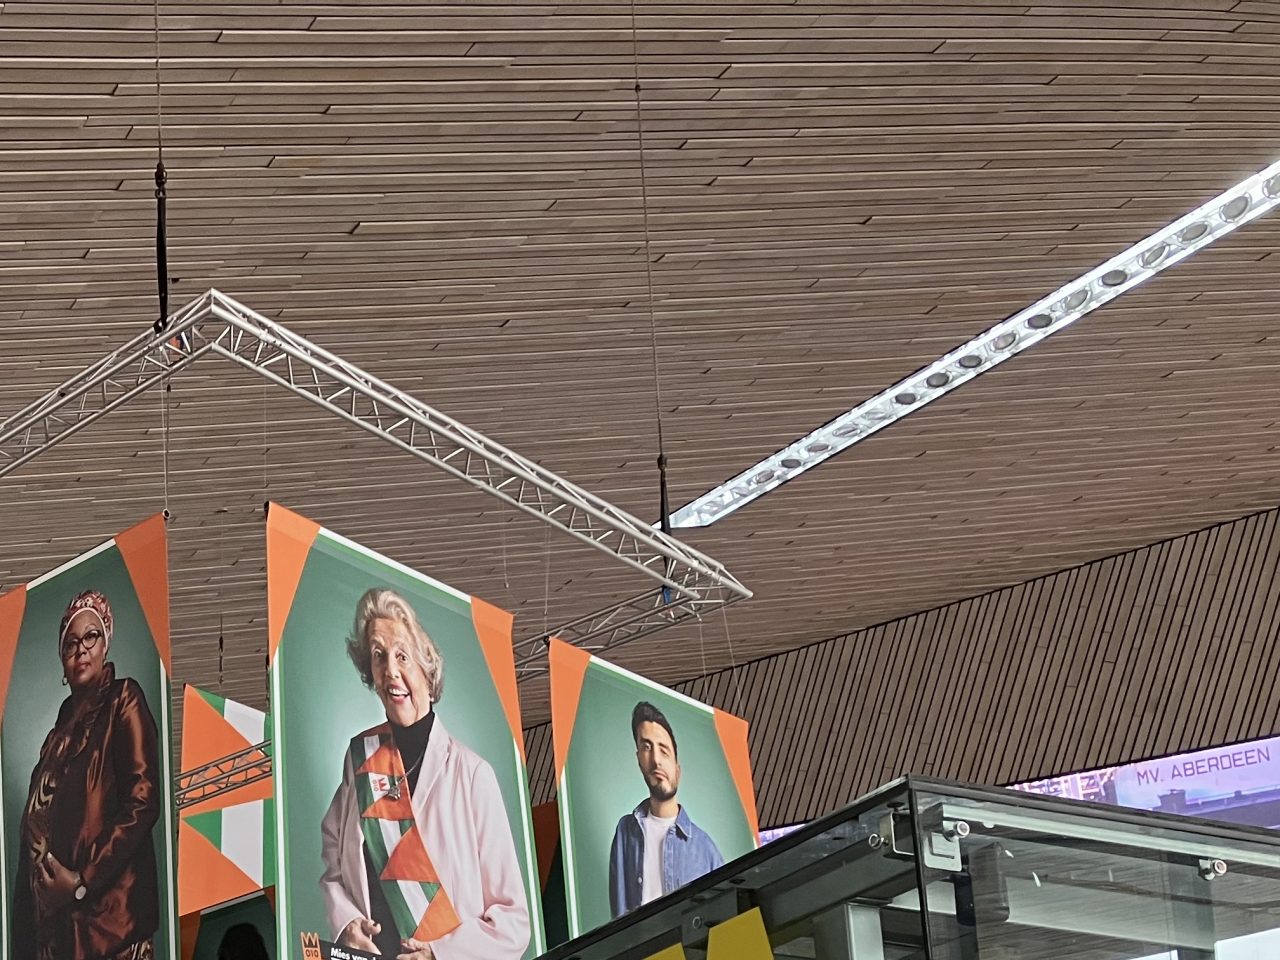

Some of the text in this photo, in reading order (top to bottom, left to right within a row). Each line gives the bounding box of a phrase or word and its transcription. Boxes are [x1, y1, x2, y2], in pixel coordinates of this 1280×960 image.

[1136, 746, 1271, 786] MV. ABERDEEN
[331, 947, 351, 960] Mies
